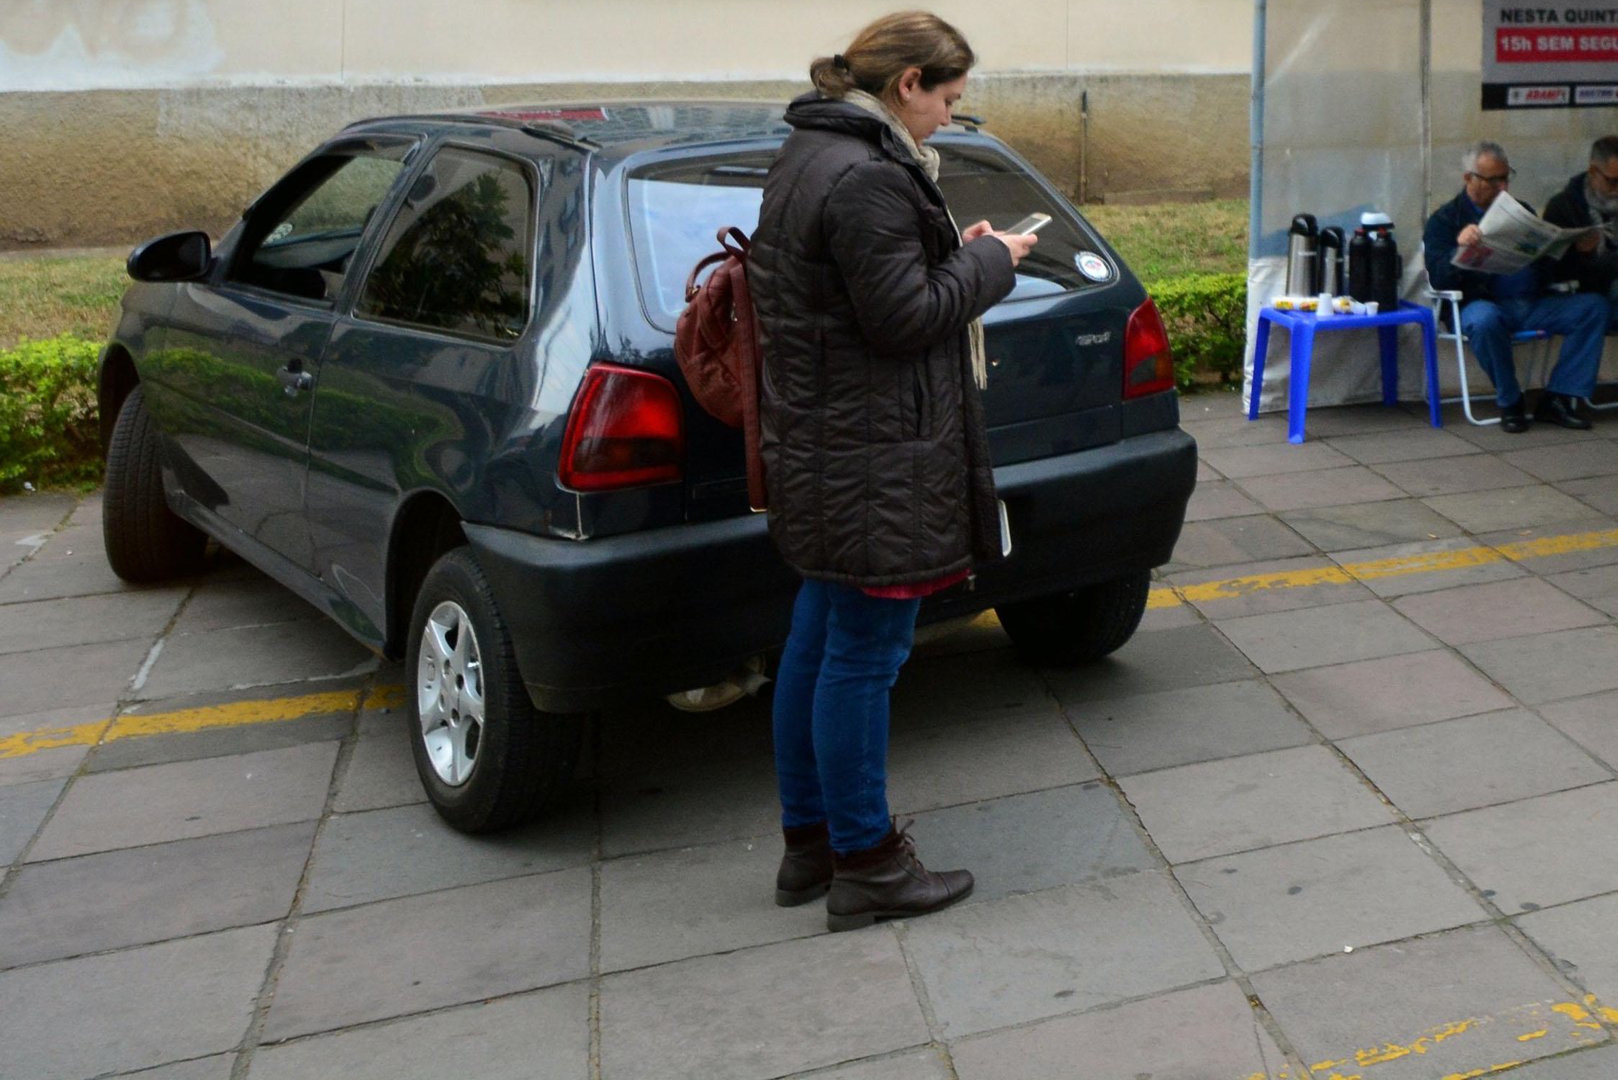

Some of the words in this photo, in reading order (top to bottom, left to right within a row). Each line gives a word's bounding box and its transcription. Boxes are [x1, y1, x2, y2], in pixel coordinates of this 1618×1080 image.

[1500, 7, 1558, 24] NESTA
[1500, 35, 1532, 53] 15h
[1537, 35, 1575, 52] SEM
